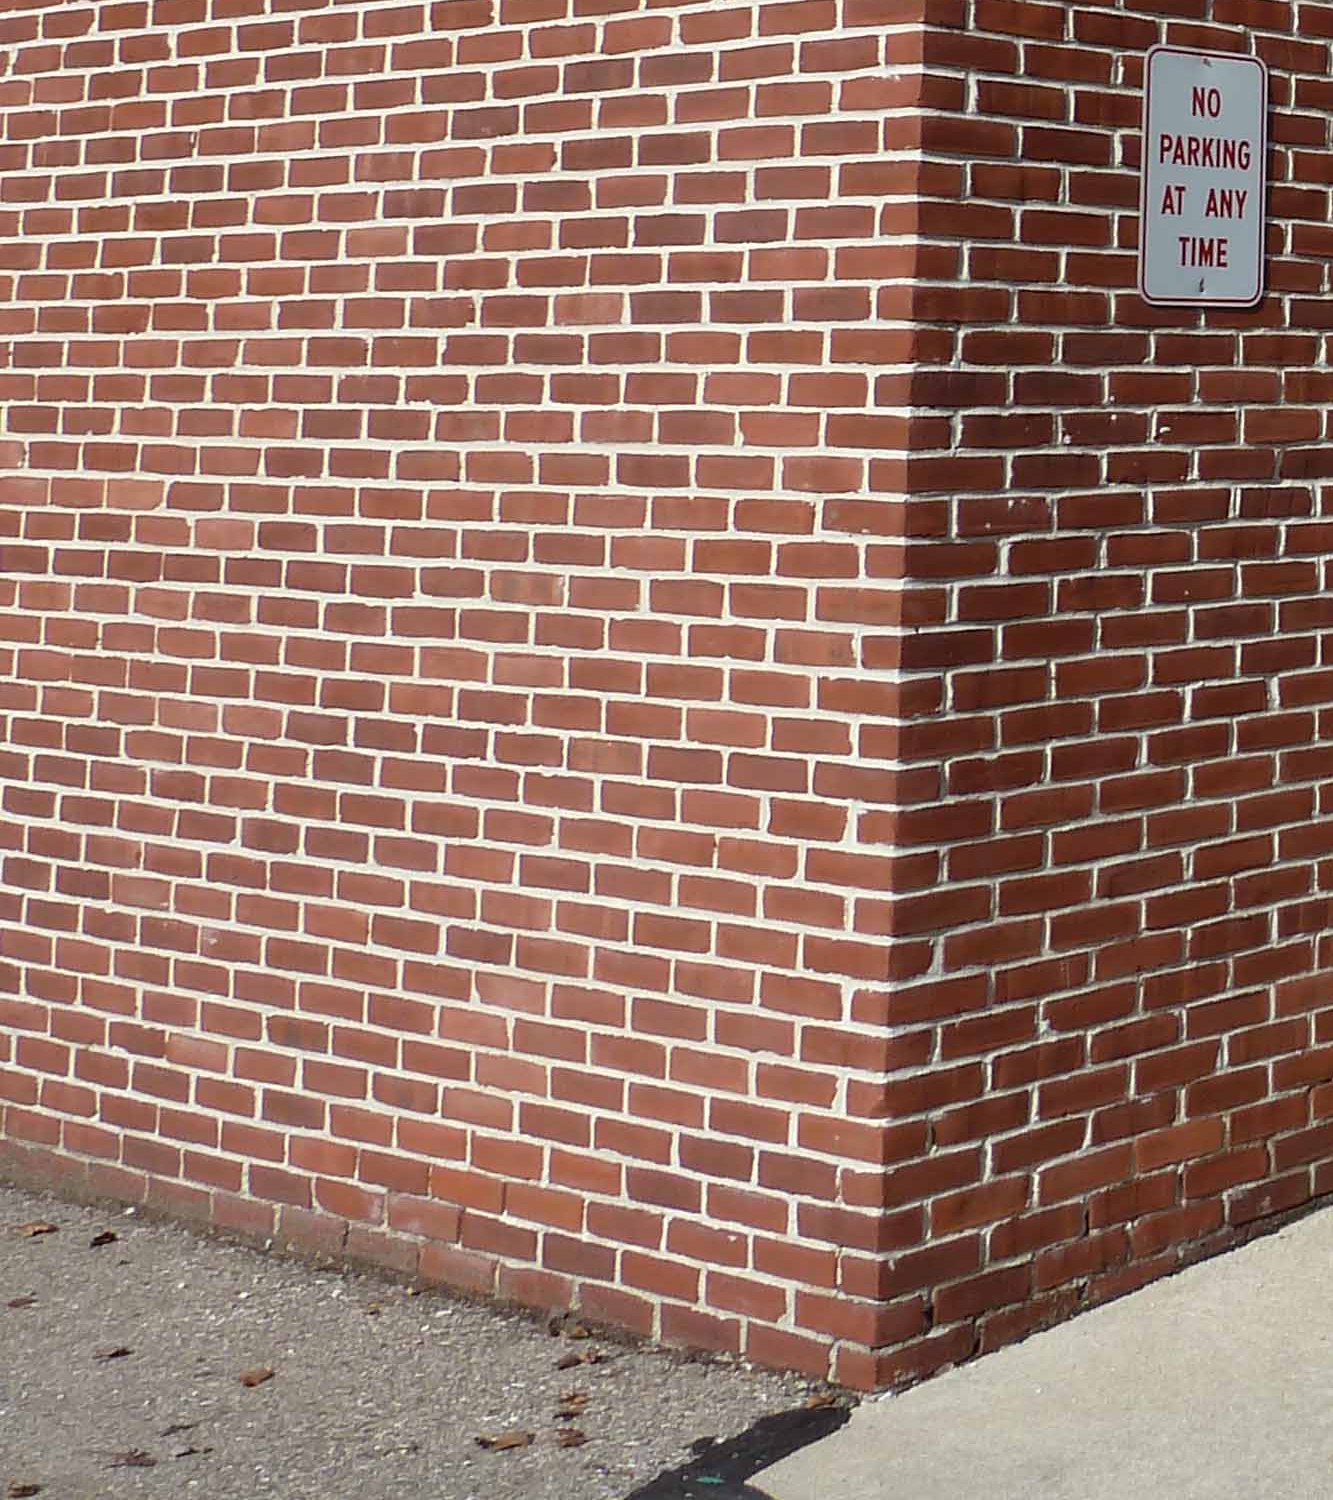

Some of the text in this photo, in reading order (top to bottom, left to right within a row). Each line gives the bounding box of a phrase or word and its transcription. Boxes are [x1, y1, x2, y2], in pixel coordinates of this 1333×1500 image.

[1191, 86, 1221, 117] NO
[1159, 134, 1250, 170] PARKING
[1161, 185, 1248, 219] AT ANY
[1178, 237, 1228, 268] TIME
